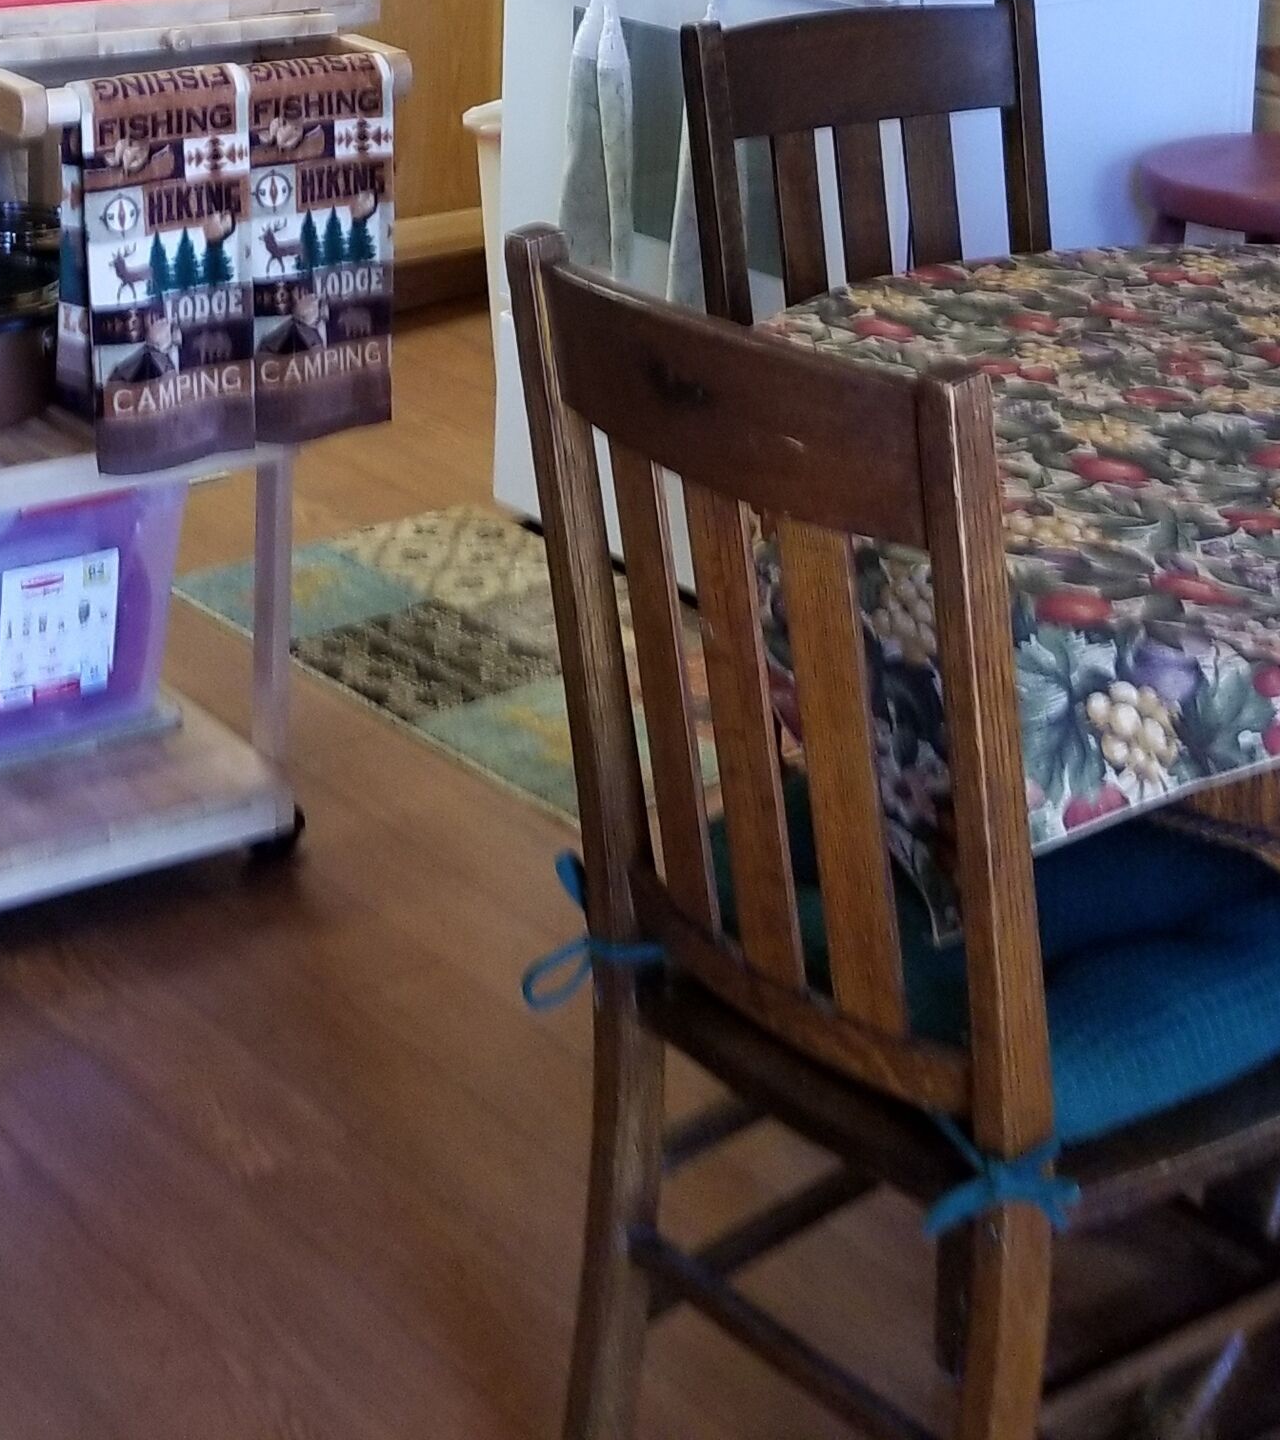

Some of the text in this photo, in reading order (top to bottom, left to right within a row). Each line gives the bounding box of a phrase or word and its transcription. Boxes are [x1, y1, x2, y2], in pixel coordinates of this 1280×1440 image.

[94, 66, 231, 101] FISHING
[99, 104, 233, 146] FISHING
[253, 89, 380, 128] FISHING
[301, 162, 385, 203] HIKING
[148, 180, 242, 227] HIKING
[315, 267, 384, 300] LODGE
[165, 287, 243, 323] LODGE
[260, 341, 381, 384] CAMPING
[113, 365, 241, 416] CAMPING
